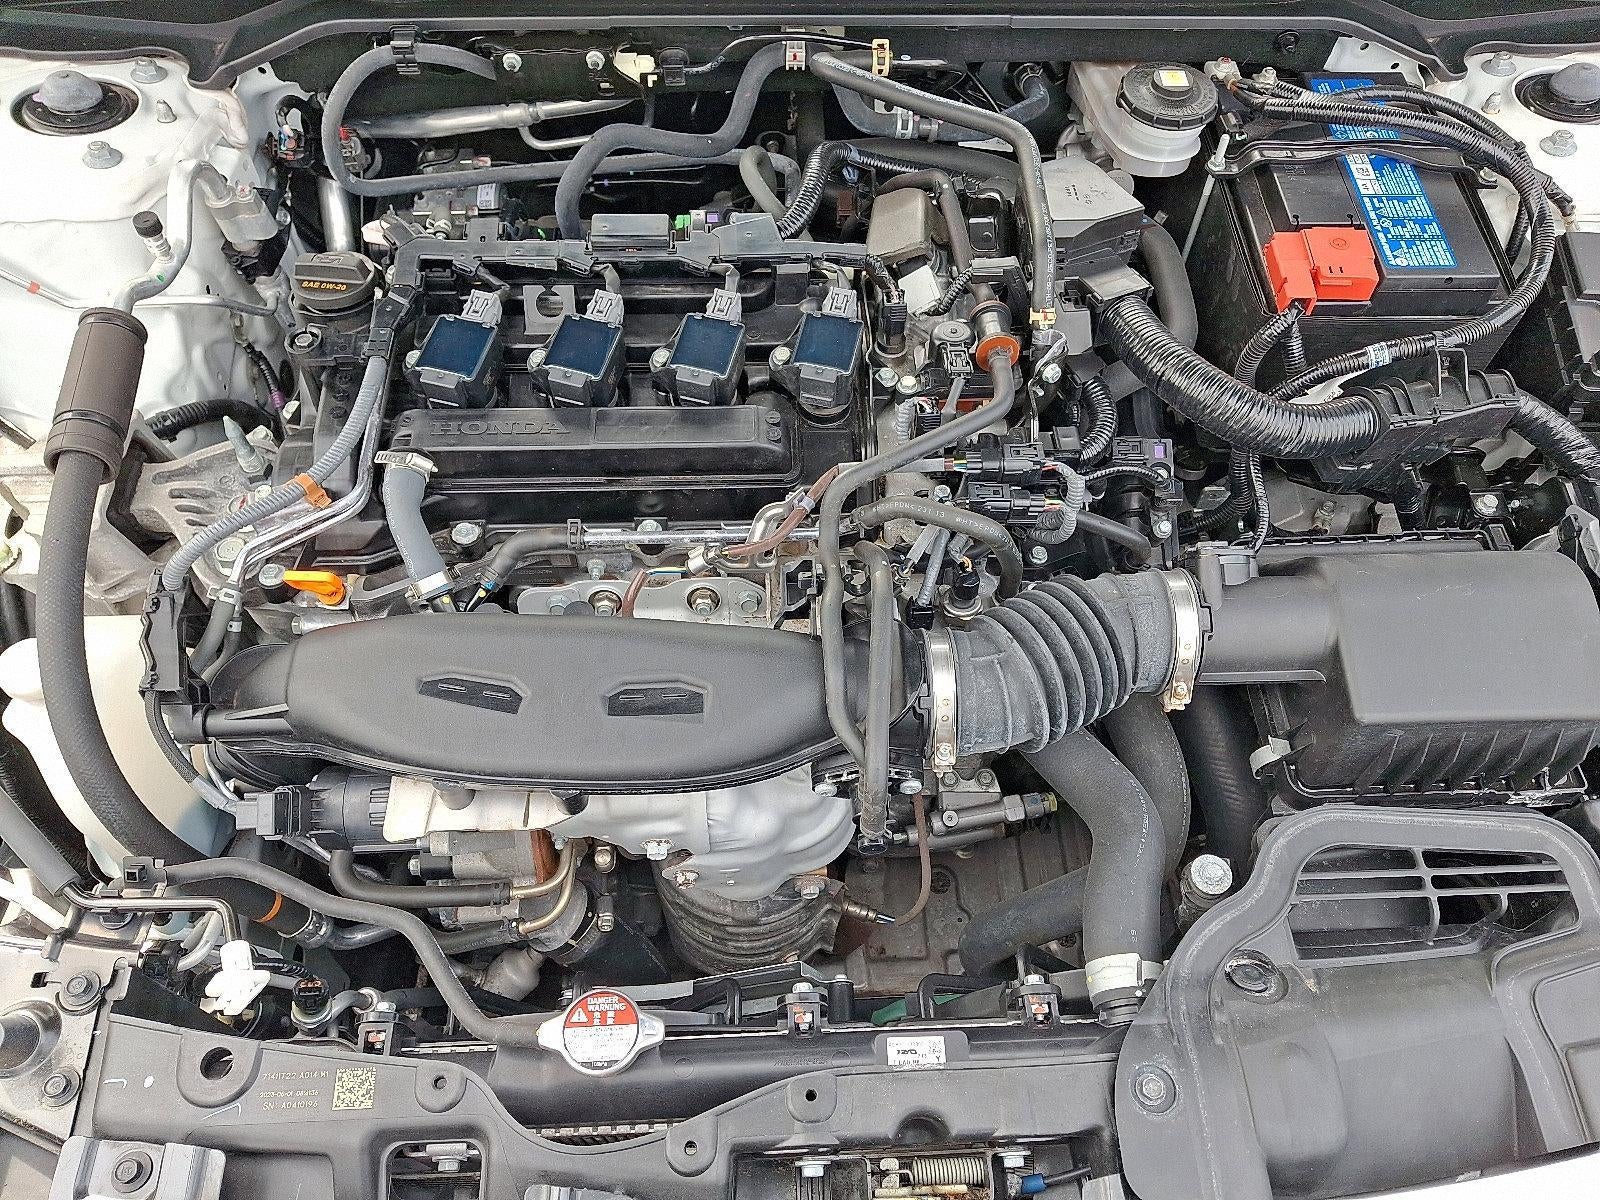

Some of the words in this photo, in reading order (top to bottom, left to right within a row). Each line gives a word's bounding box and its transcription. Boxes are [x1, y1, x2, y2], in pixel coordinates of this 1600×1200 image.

[320, 282, 347, 291] 0W-20
[430, 420, 570, 435] HONDA
[587, 995, 619, 1004] DANGER
[587, 1003, 627, 1012] WARNING
